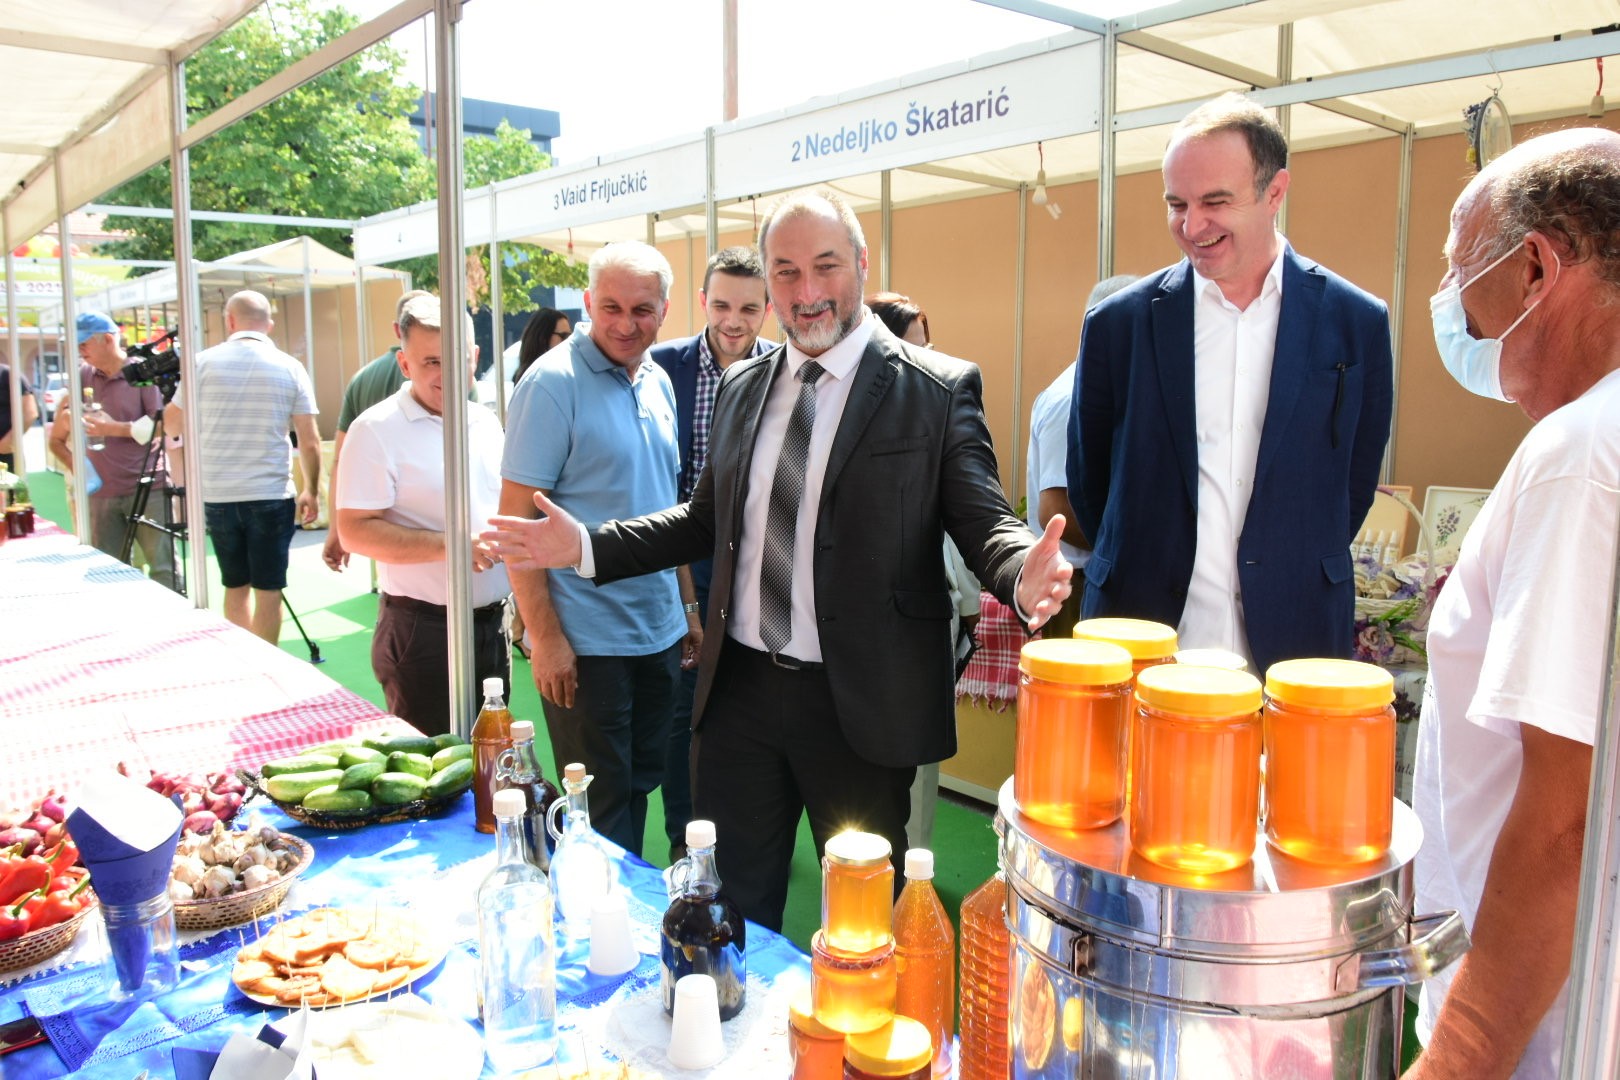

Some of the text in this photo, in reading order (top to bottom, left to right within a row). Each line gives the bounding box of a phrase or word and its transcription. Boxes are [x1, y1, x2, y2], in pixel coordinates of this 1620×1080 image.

[791, 86, 1010, 162] 2 Nedeljko Škatarić
[553, 170, 648, 210] 3 Vaid Frljučkić
